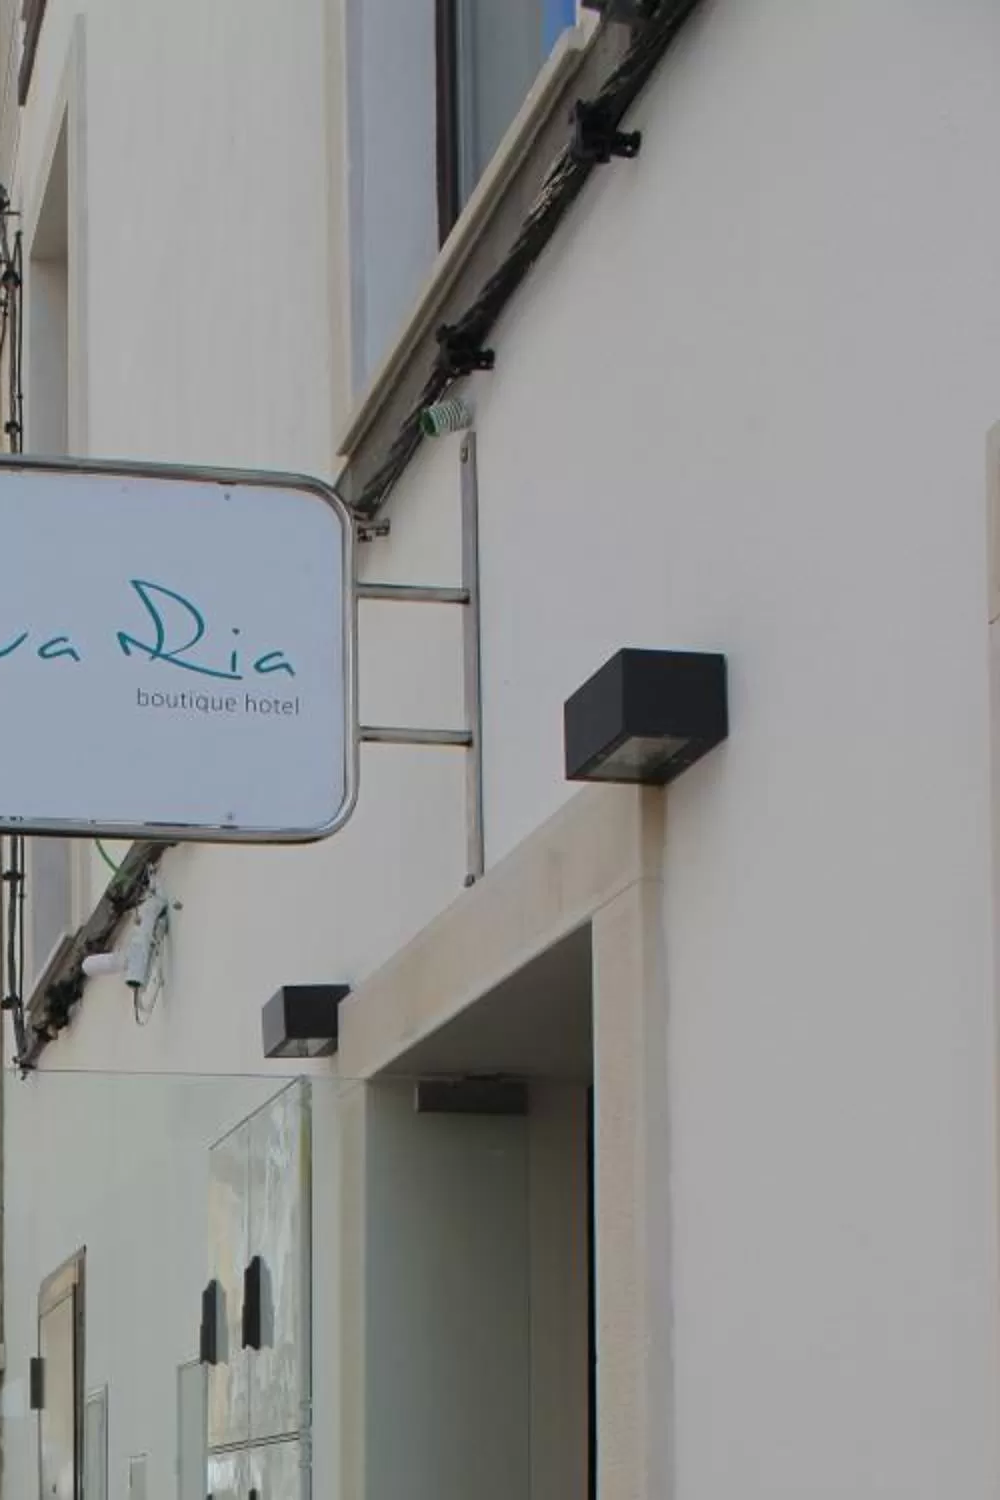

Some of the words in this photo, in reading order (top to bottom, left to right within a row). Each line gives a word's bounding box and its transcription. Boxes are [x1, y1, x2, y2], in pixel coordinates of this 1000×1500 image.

[114, 577, 297, 680] Ria
[136, 687, 237, 713] boutique
[245, 692, 300, 716] hotel
